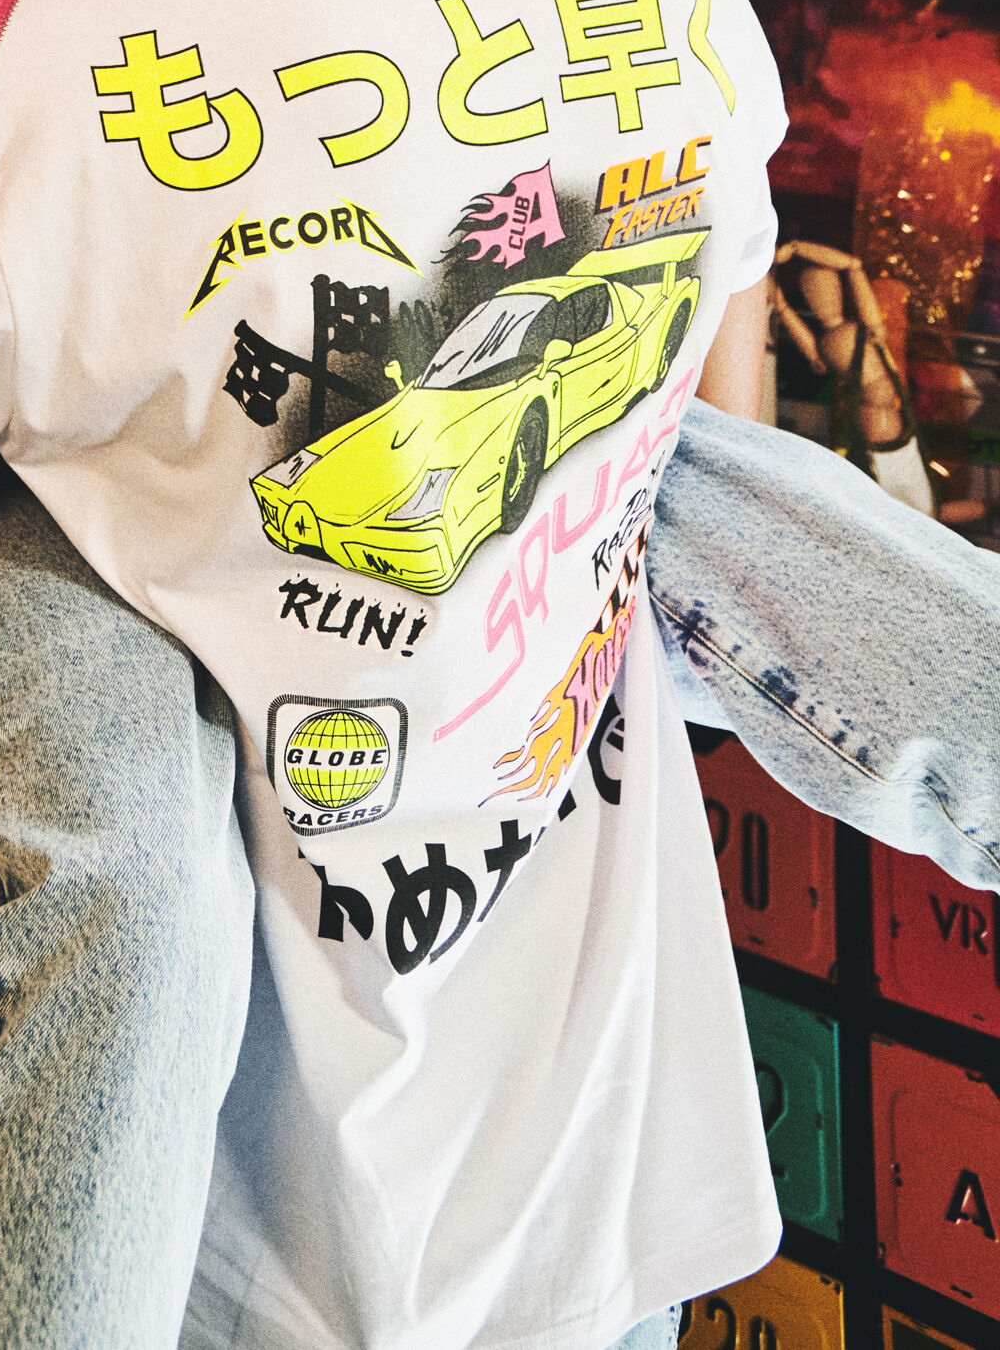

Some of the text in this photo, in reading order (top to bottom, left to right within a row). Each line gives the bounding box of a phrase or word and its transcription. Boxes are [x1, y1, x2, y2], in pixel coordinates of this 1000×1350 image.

[508, 195, 531, 251] CLUB
[601, 186, 706, 249] FASTER
[183, 196, 425, 321] RECORD
[279, 574, 428, 658] RUN!
[287, 748, 387, 767] GLOBE
[283, 804, 384, 827] RACERS
